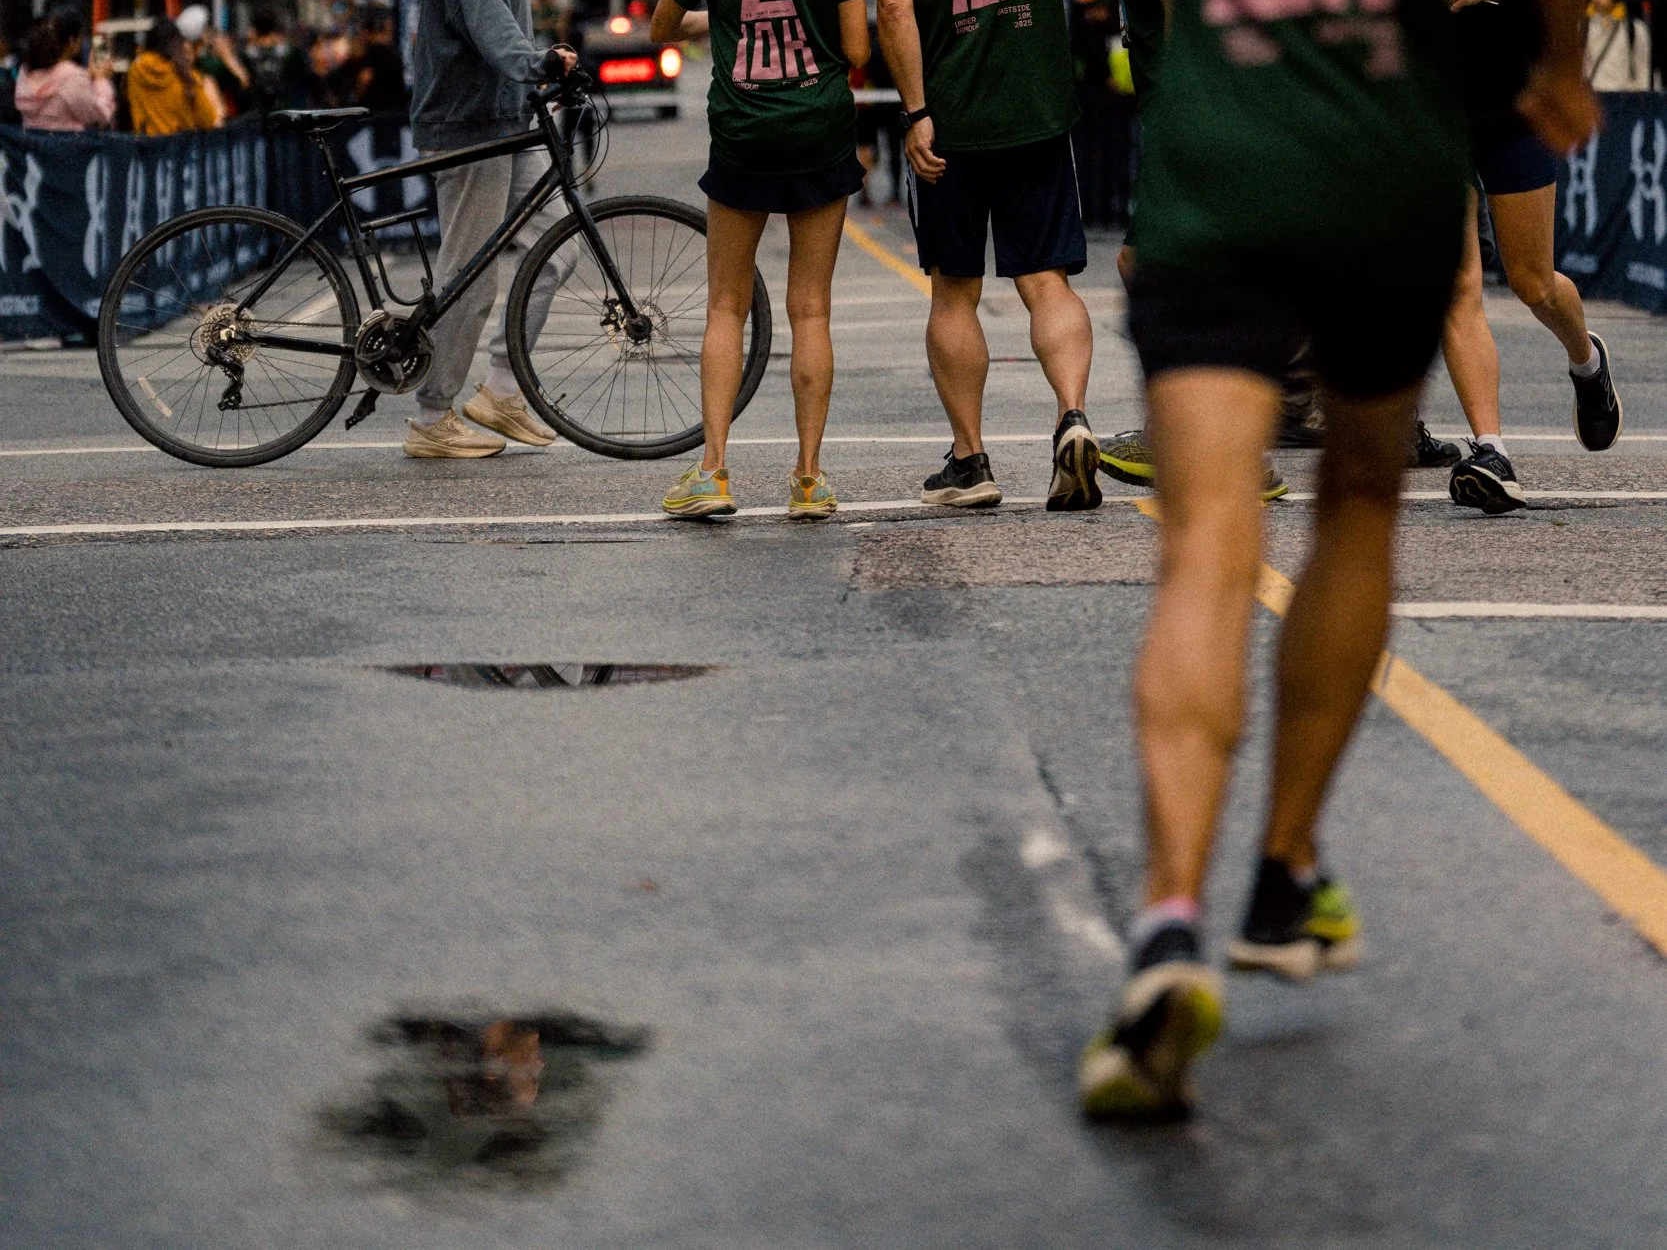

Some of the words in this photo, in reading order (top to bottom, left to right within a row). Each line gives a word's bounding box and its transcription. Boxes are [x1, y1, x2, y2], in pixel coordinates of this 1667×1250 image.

[1017, 11, 1032, 20] 10K
[954, 16, 977, 29] UNDER
[1014, 19, 1033, 29] 2025
[732, 18, 820, 82] 10K
[799, 77, 818, 88] 2025
